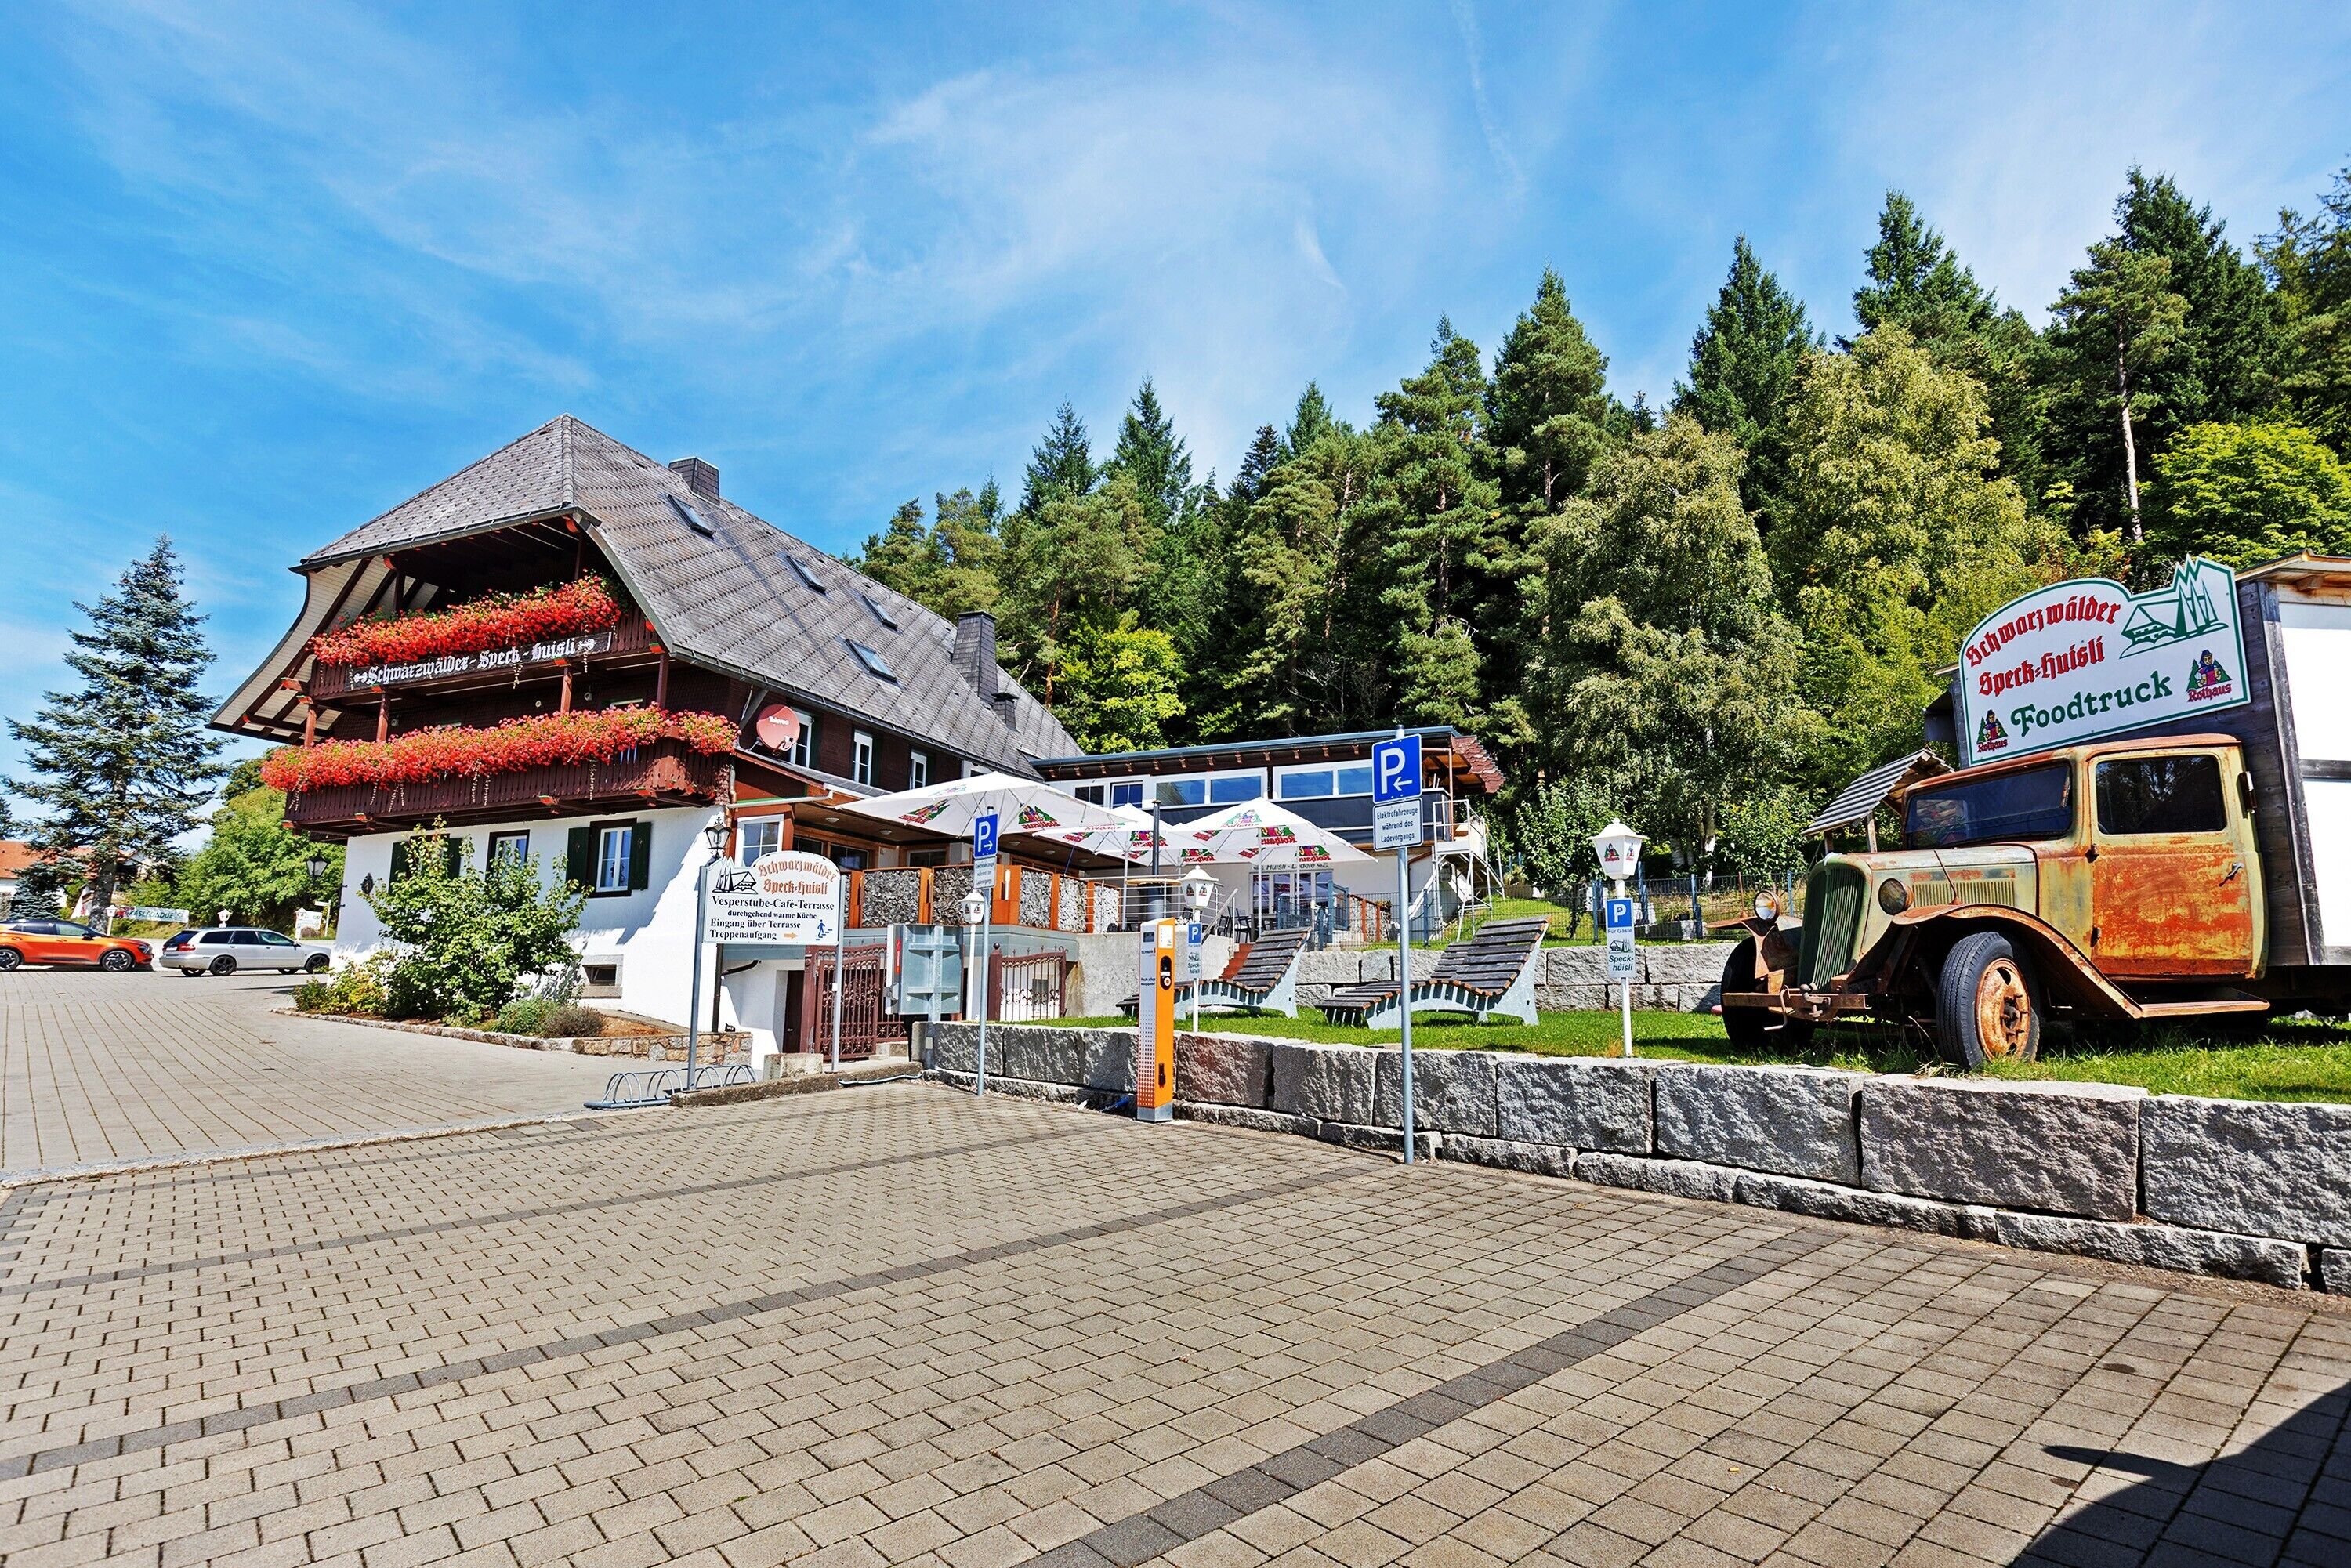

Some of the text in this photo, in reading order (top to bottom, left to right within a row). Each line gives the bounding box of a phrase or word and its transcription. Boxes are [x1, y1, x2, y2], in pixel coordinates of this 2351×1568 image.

[1965, 594, 2121, 667] Schwarzwälder
[2187, 682, 2233, 703] Rothaus
[2010, 670, 2173, 737] Foodtruck
[1976, 738, 2009, 753] Rothaus
[1380, 748, 1406, 795] P
[1377, 808, 1418, 820] Elektrofahrzeuge
[1382, 820, 1403, 831] während
[977, 820, 991, 853] P
[1381, 833, 1415, 843] Ladevorgangs
[759, 860, 837, 882] Schwarzwälder
[712, 896, 835, 911] Vesperstube-Café-Terrasse
[727, 910, 773, 918] durchgehend
[1614, 904, 1627, 923] P
[711, 918, 801, 929] Eingang über Terrasse
[709, 929, 777, 940] Treppenaufgang
[1191, 926, 1199, 940] P
